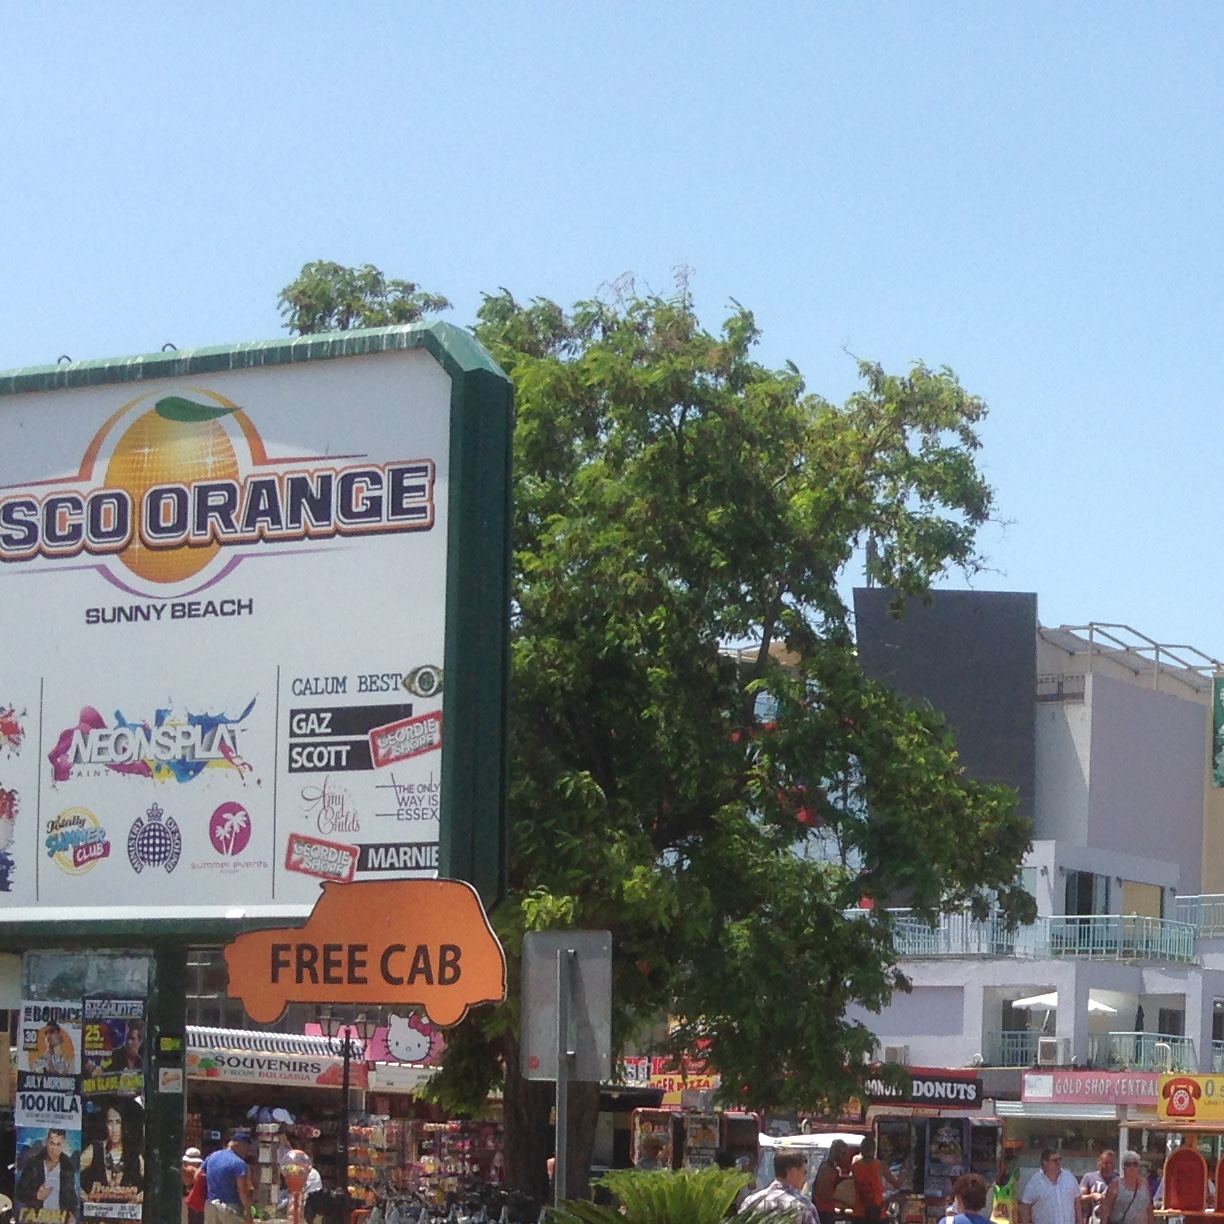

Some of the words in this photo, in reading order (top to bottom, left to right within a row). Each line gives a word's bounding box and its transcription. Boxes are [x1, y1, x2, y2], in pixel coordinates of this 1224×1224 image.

[141, 459, 436, 552] ORANGE
[85, 603, 168, 625] SUNNY
[170, 598, 254, 621] BEACH
[292, 676, 348, 696] CALUM
[357, 673, 403, 693] BEST
[292, 712, 333, 734] GAZ
[377, 717, 437, 748] GEORDIE
[291, 745, 352, 769] SCOTT
[397, 784, 415, 794] THE
[400, 795, 424, 807] WAY
[428, 794, 440, 807] IS
[397, 809, 440, 822] ESSEX
[76, 843, 104, 862] CLUB
[294, 840, 351, 866] GEORDIE
[368, 846, 440, 869] MARNIE
[271, 944, 368, 985] FREE
[380, 944, 462, 985] CAB
[214, 1055, 322, 1074] SOUVENIRS
[676, 1079, 711, 1092] PZZA
[912, 1080, 977, 1100] DONUTS
[1055, 1078, 1082, 1095] GOLD
[1085, 1078, 1112, 1095] SHOP
[1114, 1079, 1158, 1096] CENTRAL
